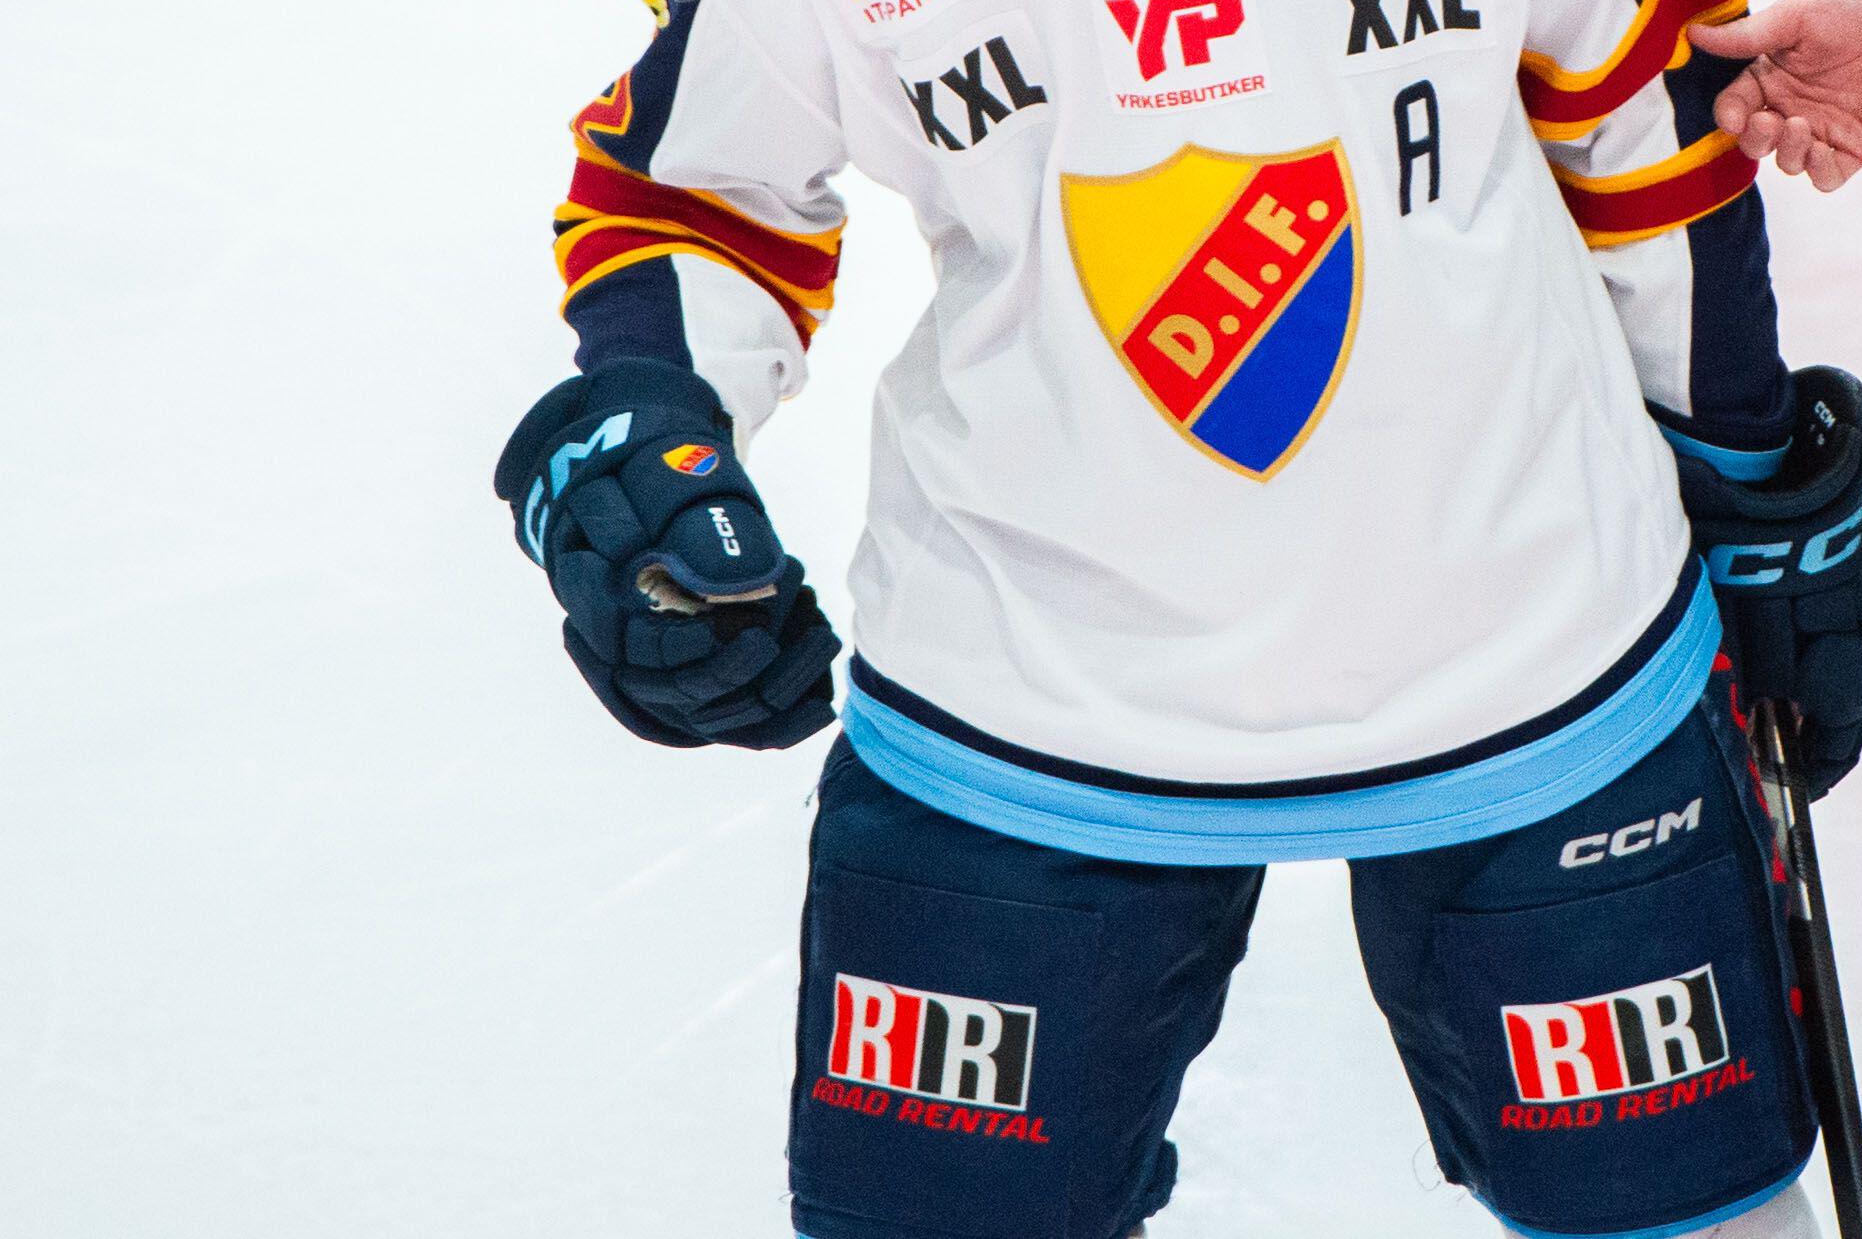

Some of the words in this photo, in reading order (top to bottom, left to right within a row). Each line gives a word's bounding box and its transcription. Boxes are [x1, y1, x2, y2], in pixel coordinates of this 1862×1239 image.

[900, 35, 1049, 151] XXL
[1115, 74, 1266, 110] YRKESBUTIKER
[1393, 79, 1441, 217] A
[1146, 192, 1330, 381] D.I.F.
[1813, 400, 1837, 428] CCM
[706, 506, 741, 557] CCM
[1557, 796, 1703, 870] CCM
[811, 1076, 891, 1118] ROAD
[897, 1096, 1050, 1144] RENTAL
[1501, 1103, 1603, 1131] ROAD
[1615, 1057, 1757, 1120] RENTAL
